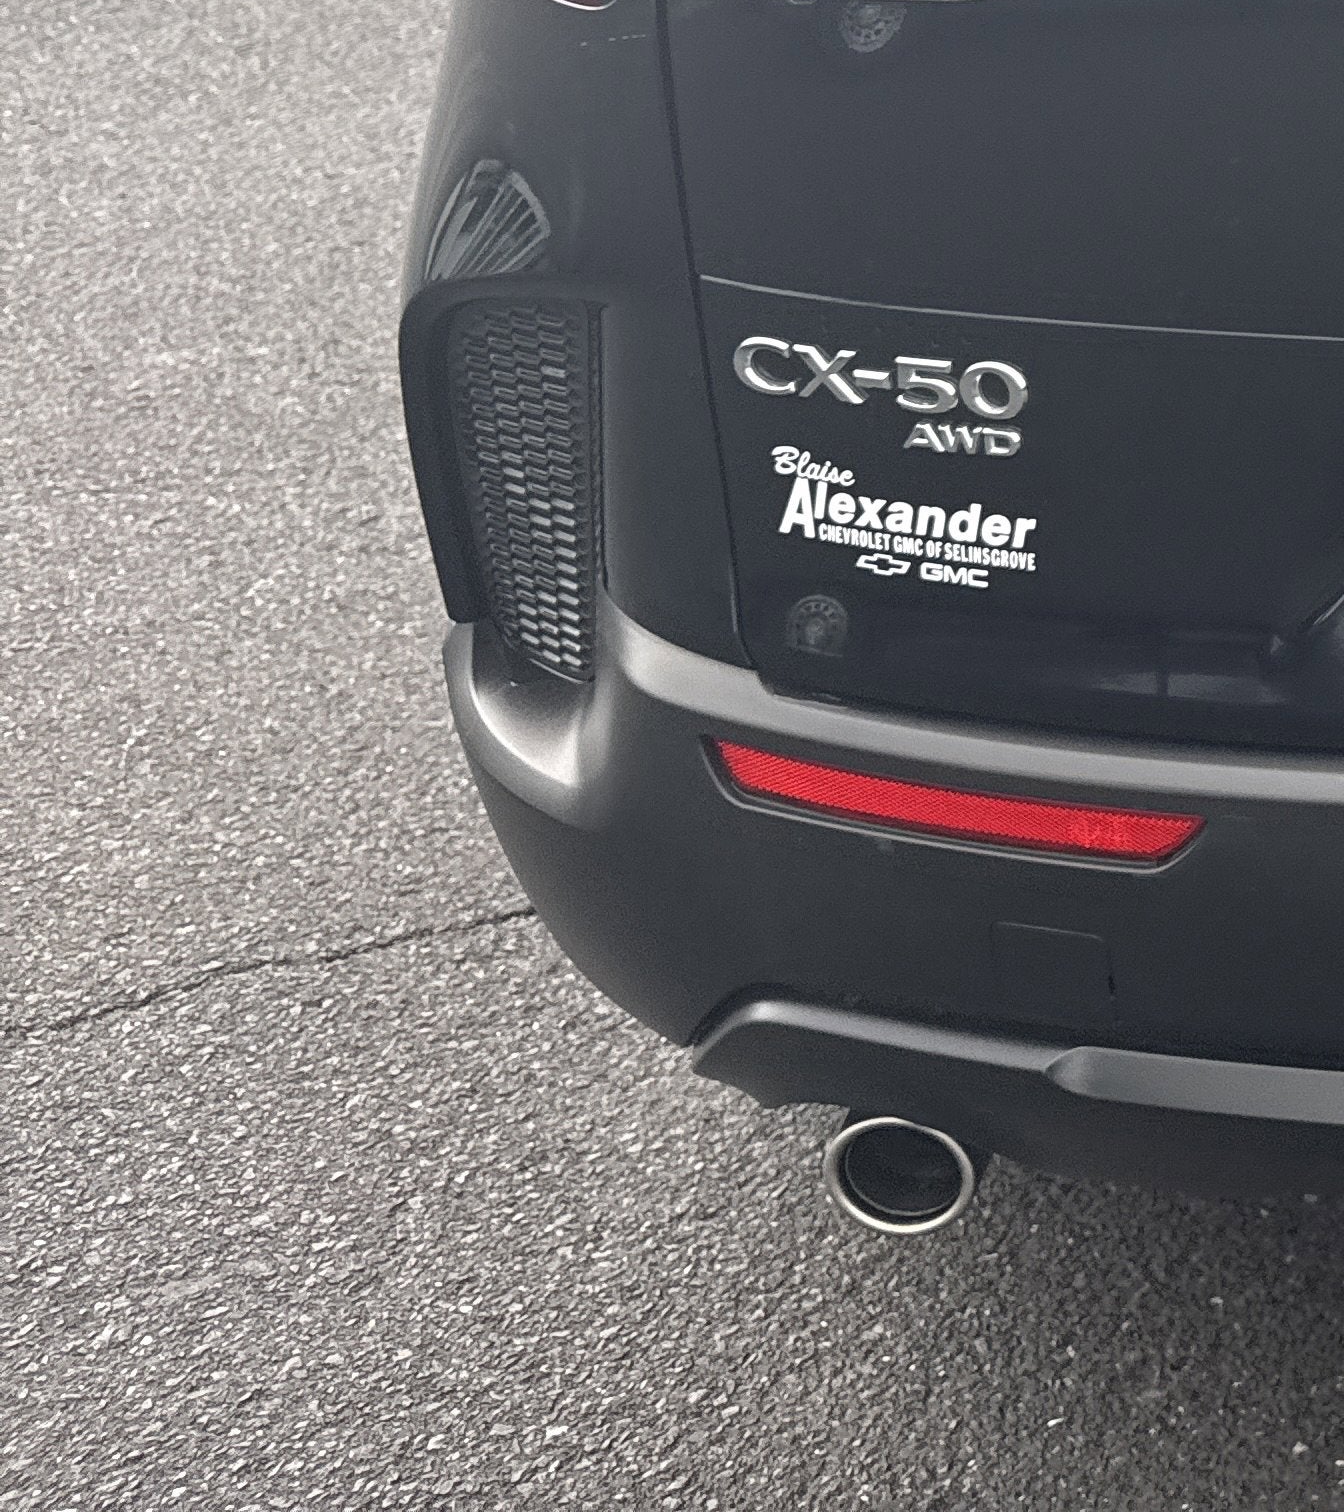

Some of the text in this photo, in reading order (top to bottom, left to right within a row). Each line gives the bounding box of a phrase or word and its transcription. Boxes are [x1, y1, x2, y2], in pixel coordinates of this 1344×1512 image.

[733, 336, 1028, 419] CX-50
[903, 423, 1022, 457] AWD
[771, 445, 856, 487] Blaise
[778, 476, 1038, 549] Alexander
[818, 522, 1037, 572] CHEVROLET GMC OF SELINSGROVE
[919, 562, 990, 589] GMC
